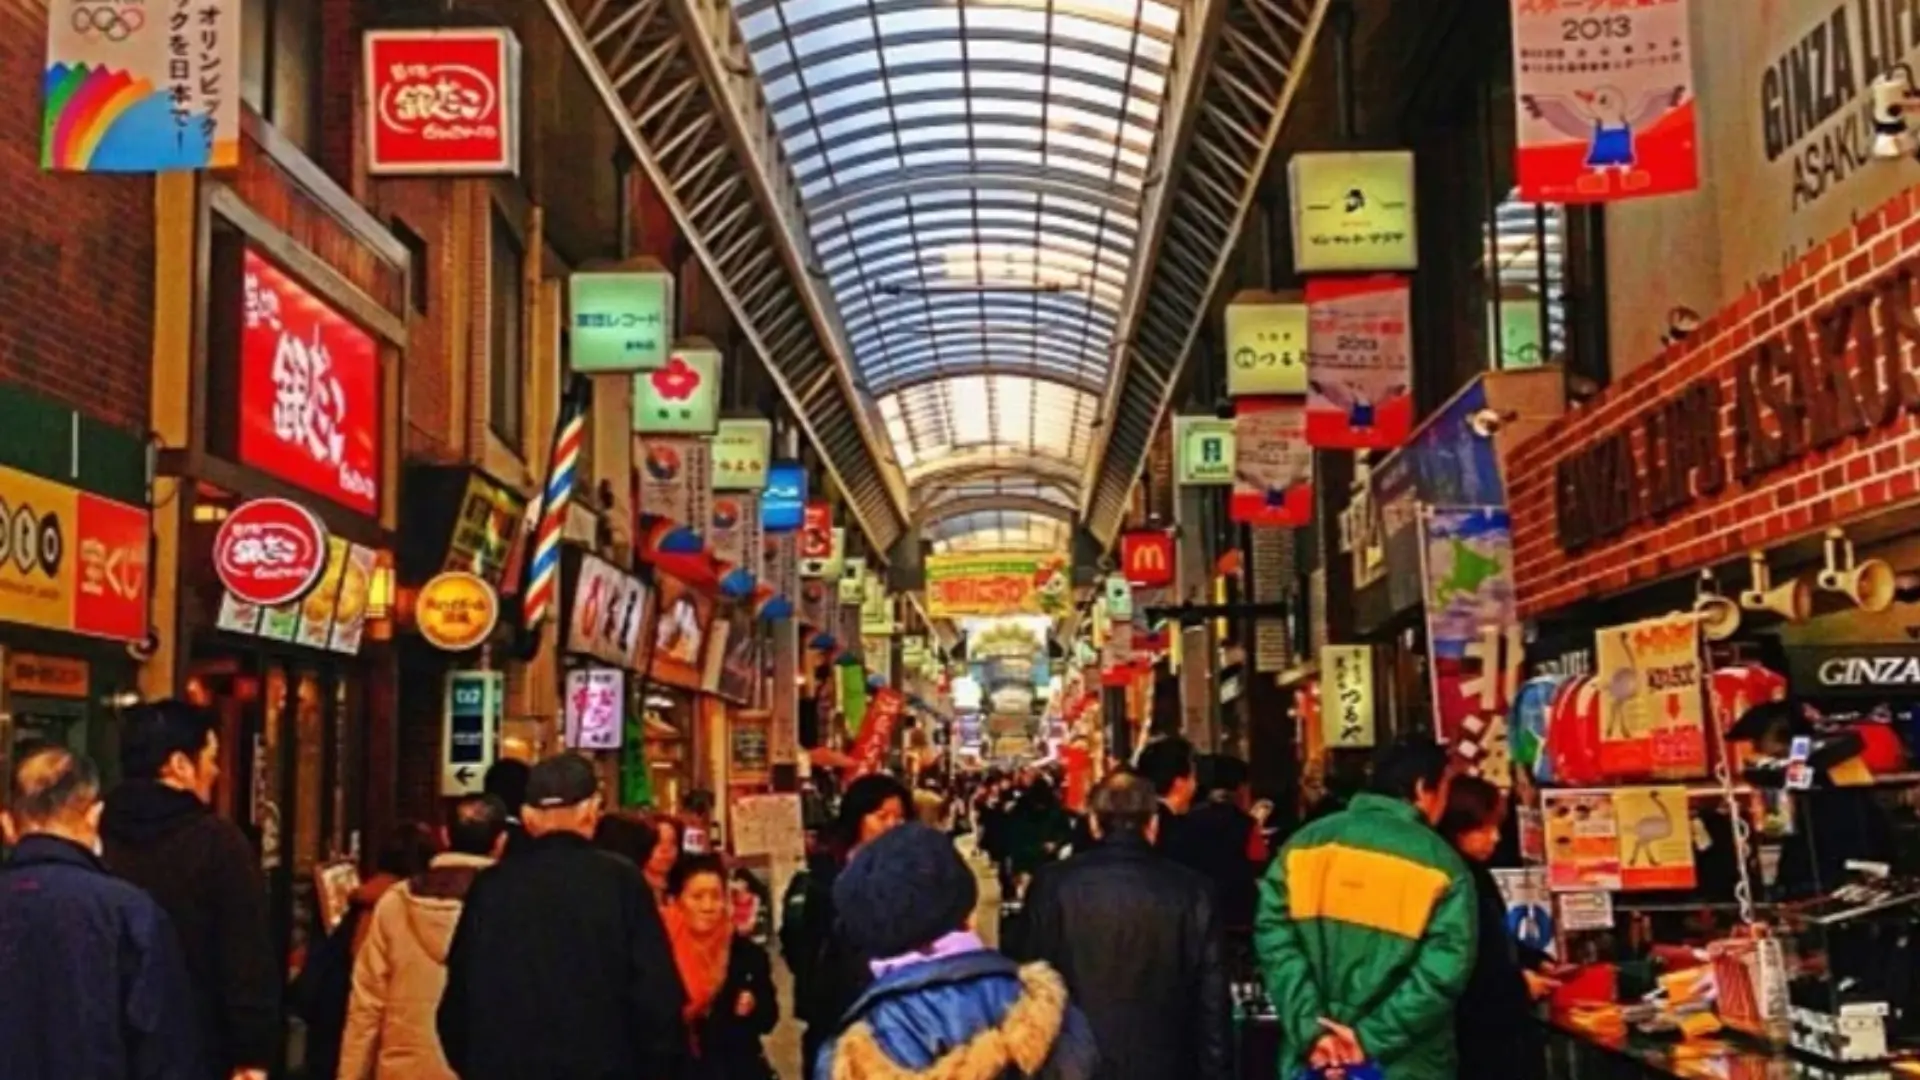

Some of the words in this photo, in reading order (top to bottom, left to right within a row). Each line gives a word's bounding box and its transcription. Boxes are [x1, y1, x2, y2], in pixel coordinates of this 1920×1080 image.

[1561, 15, 1632, 41] 2013
[1761, 3, 1857, 163] GINZA
[81, 536, 143, 602] 宝くじ
[1818, 656, 1920, 686] GINZA
[1340, 689, 1363, 741] つるや
